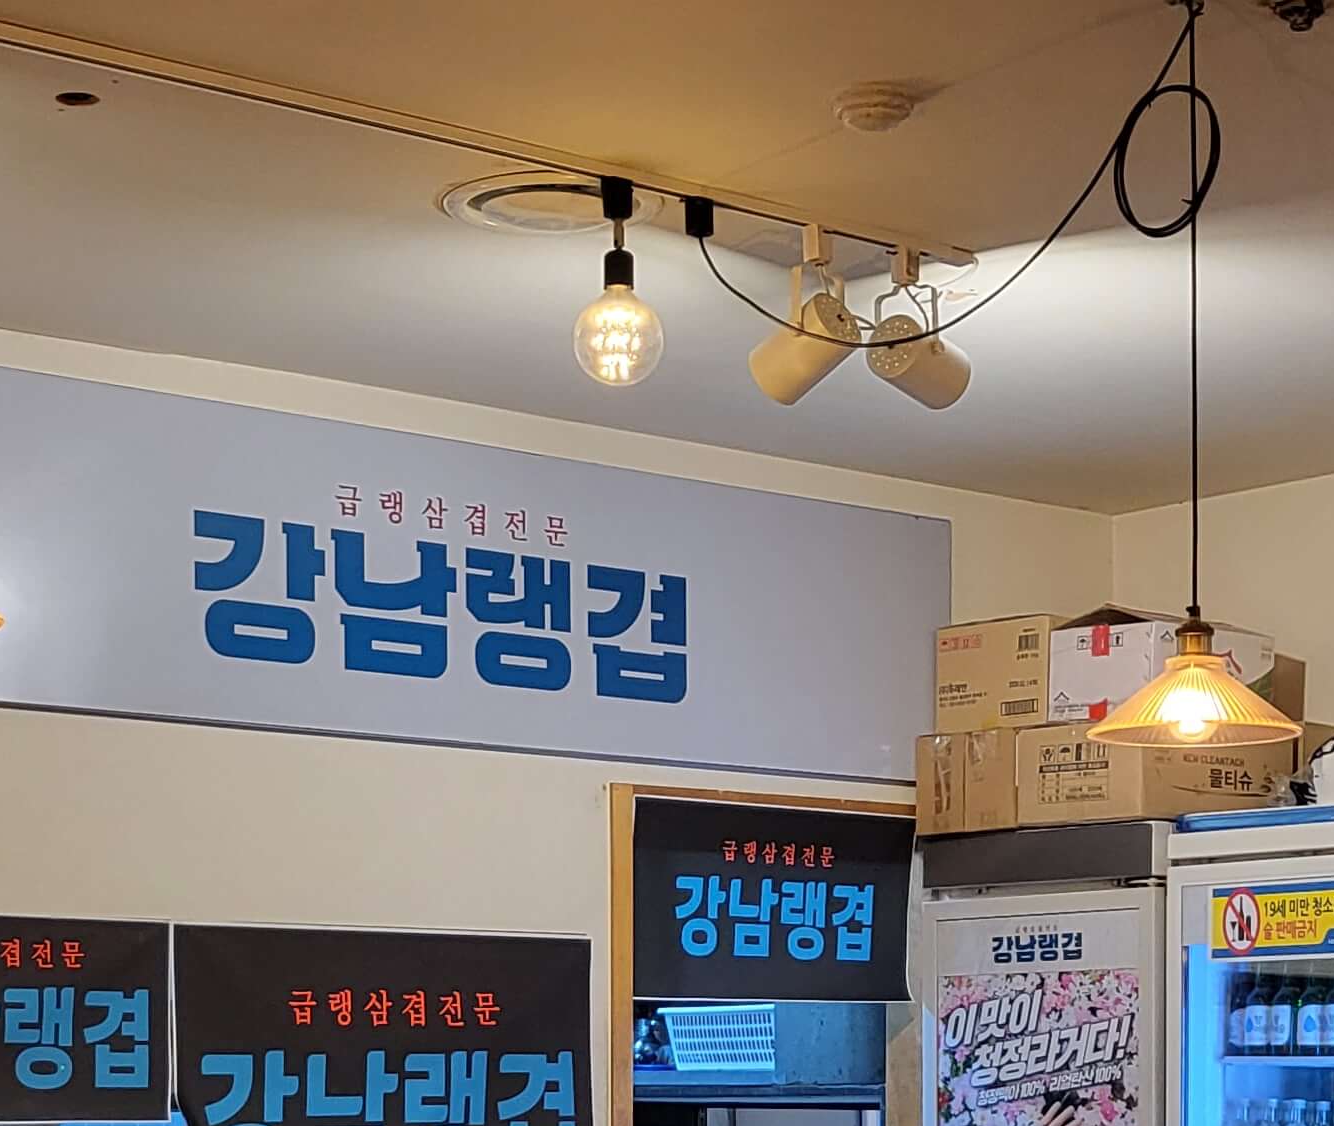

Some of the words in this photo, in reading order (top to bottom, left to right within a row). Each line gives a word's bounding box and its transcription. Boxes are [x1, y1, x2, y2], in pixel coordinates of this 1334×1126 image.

[334, 483, 569, 548] 급랭삼겹전문
[194, 509, 688, 704] 강남랭겹
[1208, 768, 1253, 791] 물티슈
[722, 840, 836, 868] 급랭삼겹전문
[675, 875, 875, 961] 강남랭겹
[1264, 899, 1286, 918] 19세
[1289, 897, 1309, 917] 미만
[1263, 922, 1273, 940] 술
[1276, 919, 1317, 939] 판매금지
[992, 932, 1083, 964] 강남랭겹
[288, 989, 501, 1027] 급랭삼겹전문
[971, 1014, 1134, 1088] 청정라거다!
[1020, 1080, 1046, 1099] 100%
[1095, 1064, 1123, 1083] 100%
